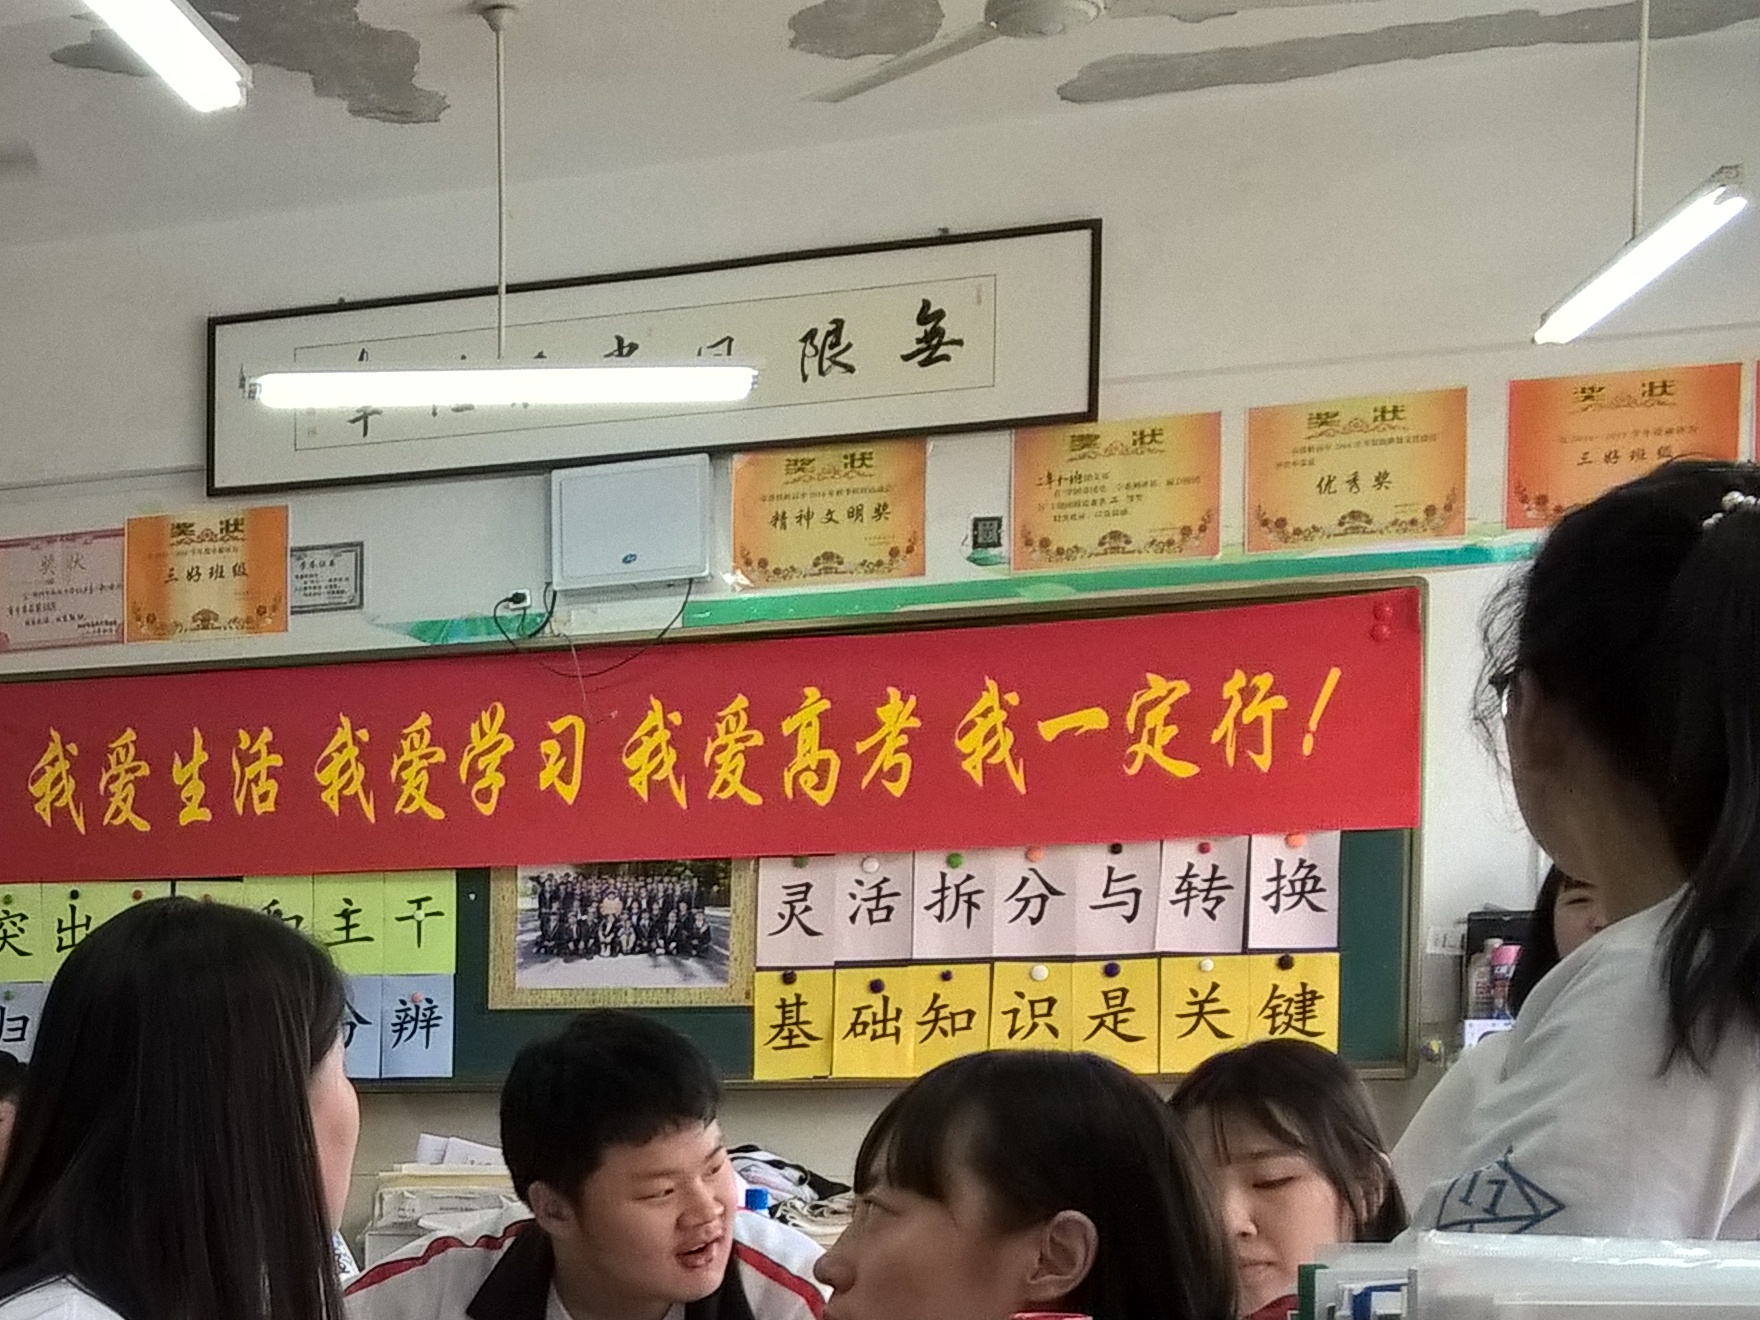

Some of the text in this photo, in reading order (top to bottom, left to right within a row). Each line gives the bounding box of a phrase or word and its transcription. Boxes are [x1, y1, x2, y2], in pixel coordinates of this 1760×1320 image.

[1316, 470, 1392, 494] 优秀奖
[770, 502, 891, 530] 精神文明奖
[164, 562, 249, 584] 三好班级
[29, 667, 1341, 834] 我爱生活 我爱学习 我爱高考 我一定行！
[767, 857, 1329, 938] 灵活拆分与转换
[763, 981, 1327, 1051] 基础知识是关键
